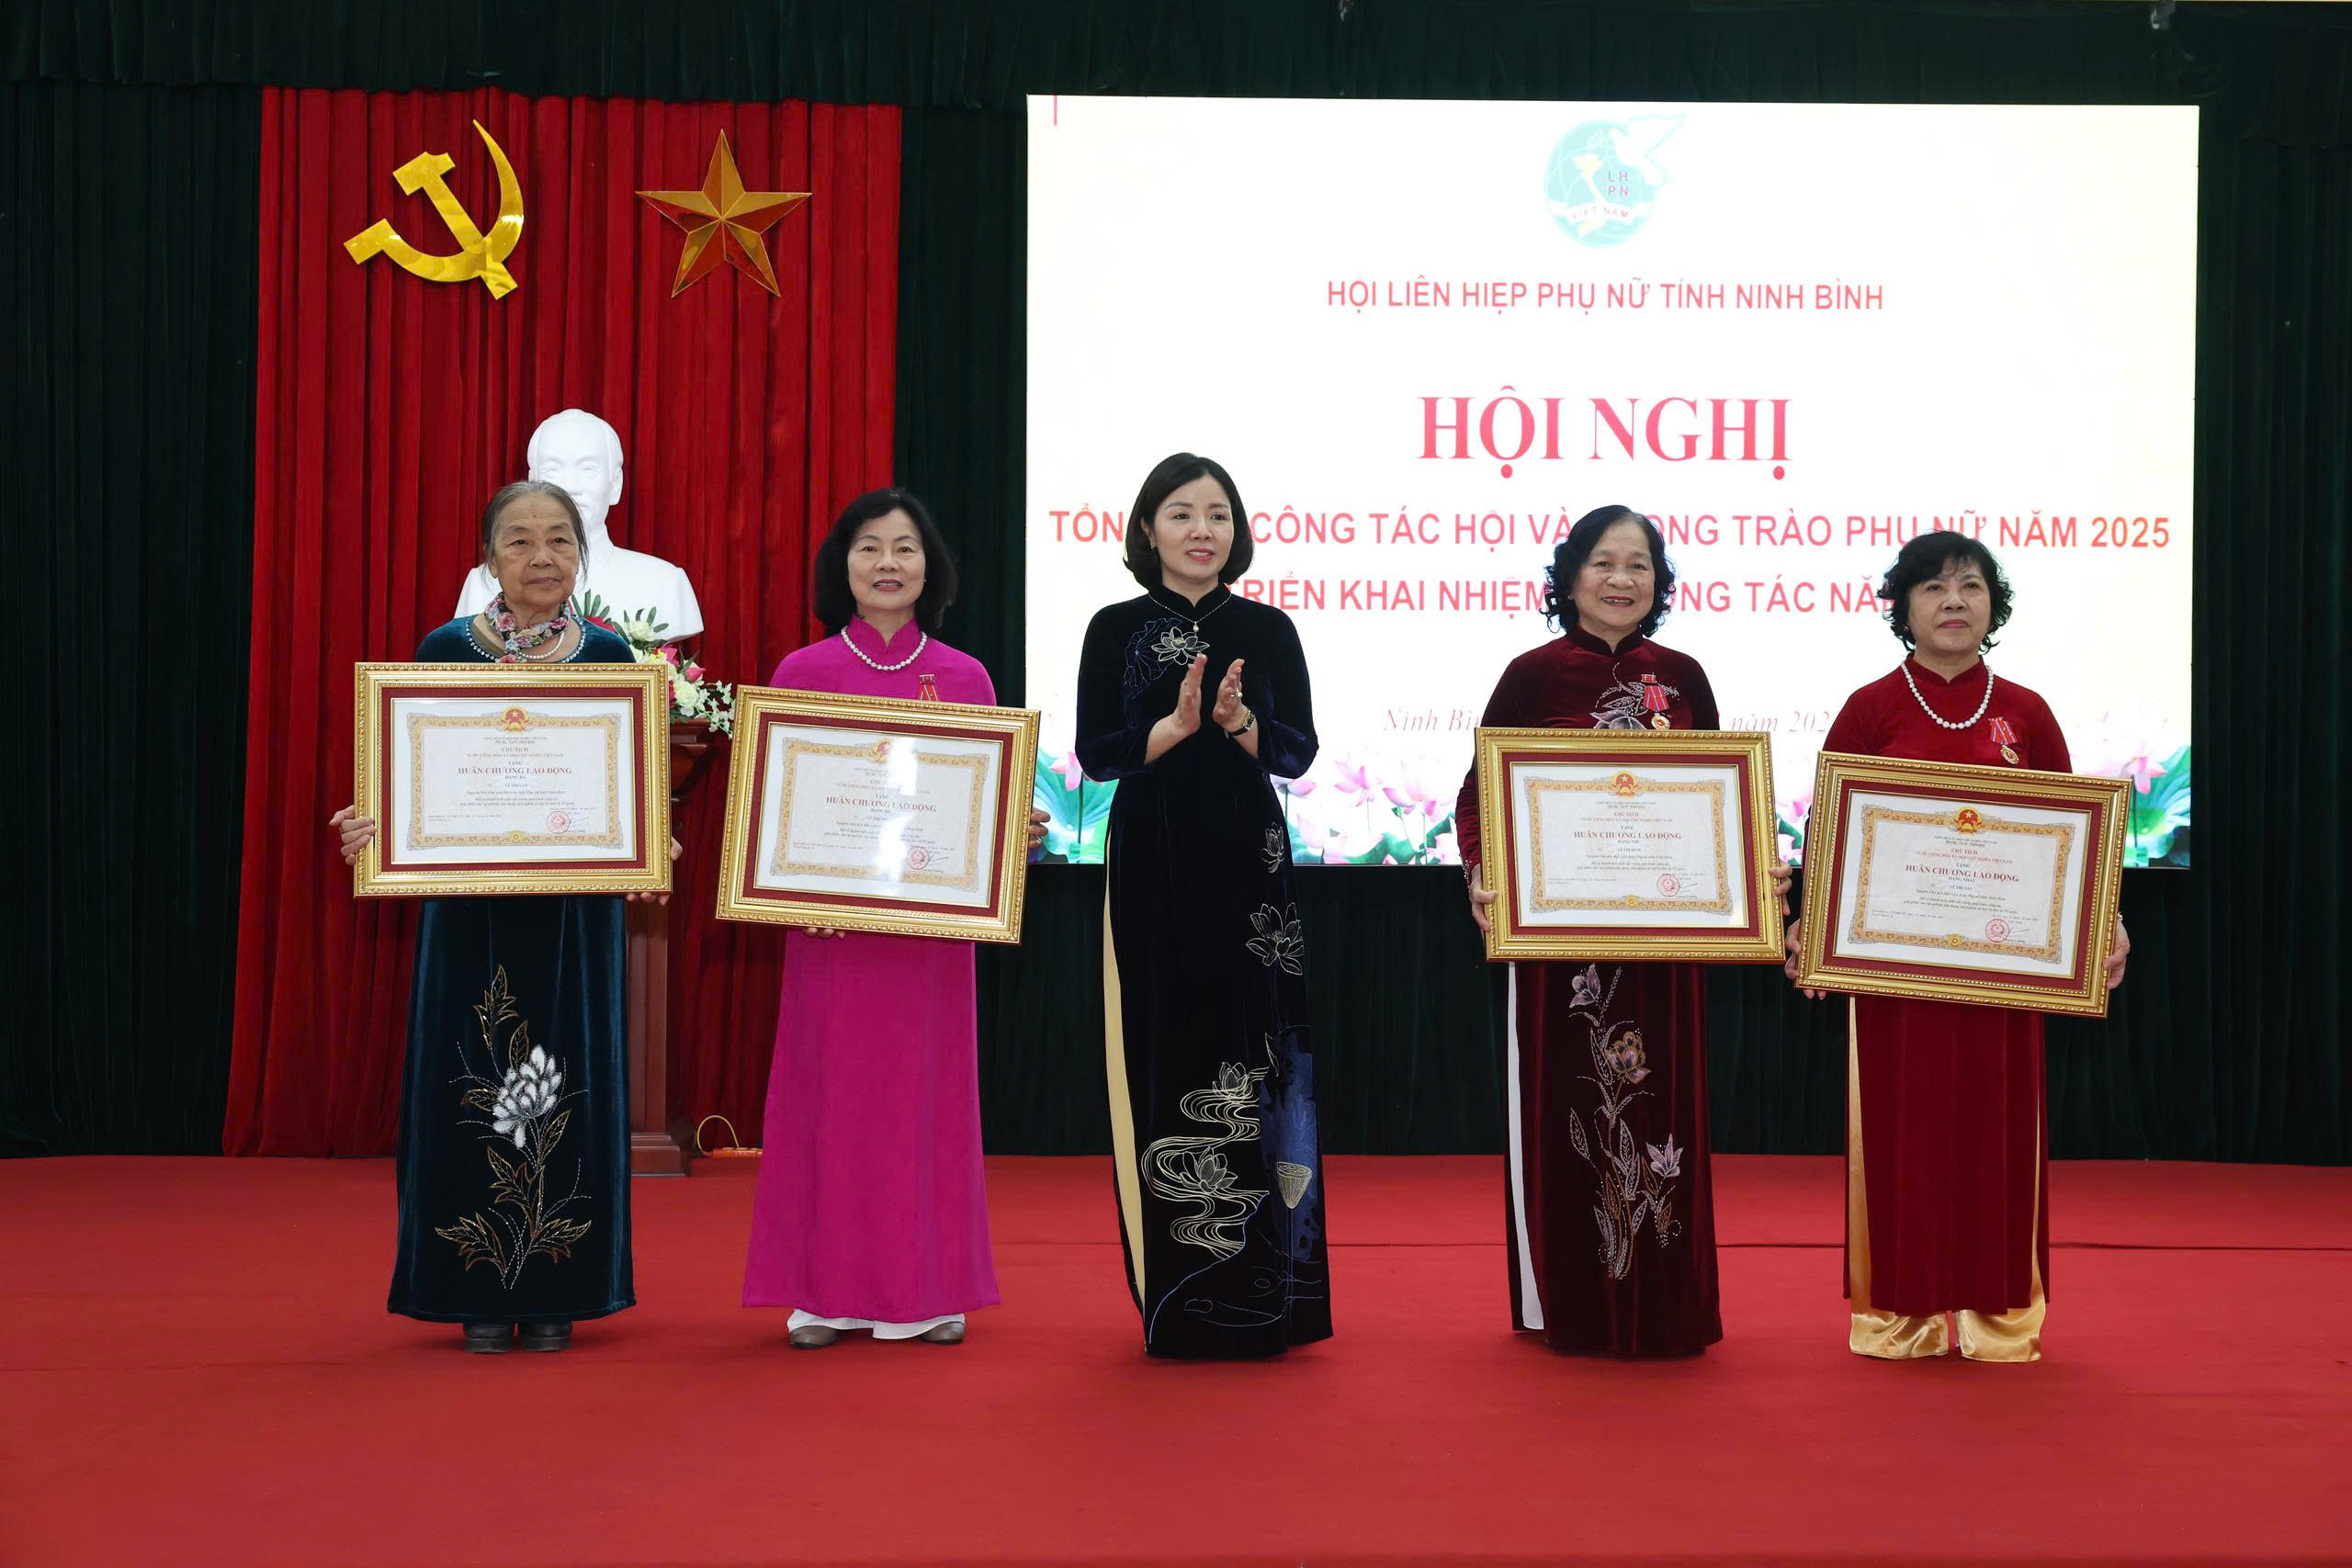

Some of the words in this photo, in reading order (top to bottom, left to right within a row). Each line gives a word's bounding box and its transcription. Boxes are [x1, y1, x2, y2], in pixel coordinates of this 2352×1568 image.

[1388, 275, 1451, 308] LIÊN
[1538, 283, 1596, 316] PHỤ
[1607, 277, 1651, 310] NỮ
[1736, 284, 1804, 310] NINH
[1815, 277, 1883, 310] BÌNH
[1417, 385, 1566, 479] HỘI
[1588, 397, 1792, 481] NGHỊ
[1049, 502, 1124, 543] TỔN
[1252, 505, 1355, 545] CÔNG
[1369, 505, 1440, 545] TÁC
[1455, 510, 1515, 553] HỘI
[1528, 506, 1573, 545] VÀ
[1732, 507, 1832, 547] TRÀO
[1999, 509, 2077, 547] NĂM
[2091, 516, 2170, 548] 2025
[1340, 580, 1425, 611] KHAI
[1744, 574, 1816, 613] TÁC
[1383, 707, 1438, 731] Ninh
[1788, 710, 1830, 733] 202
[1973, 870, 1992, 879] LAO
